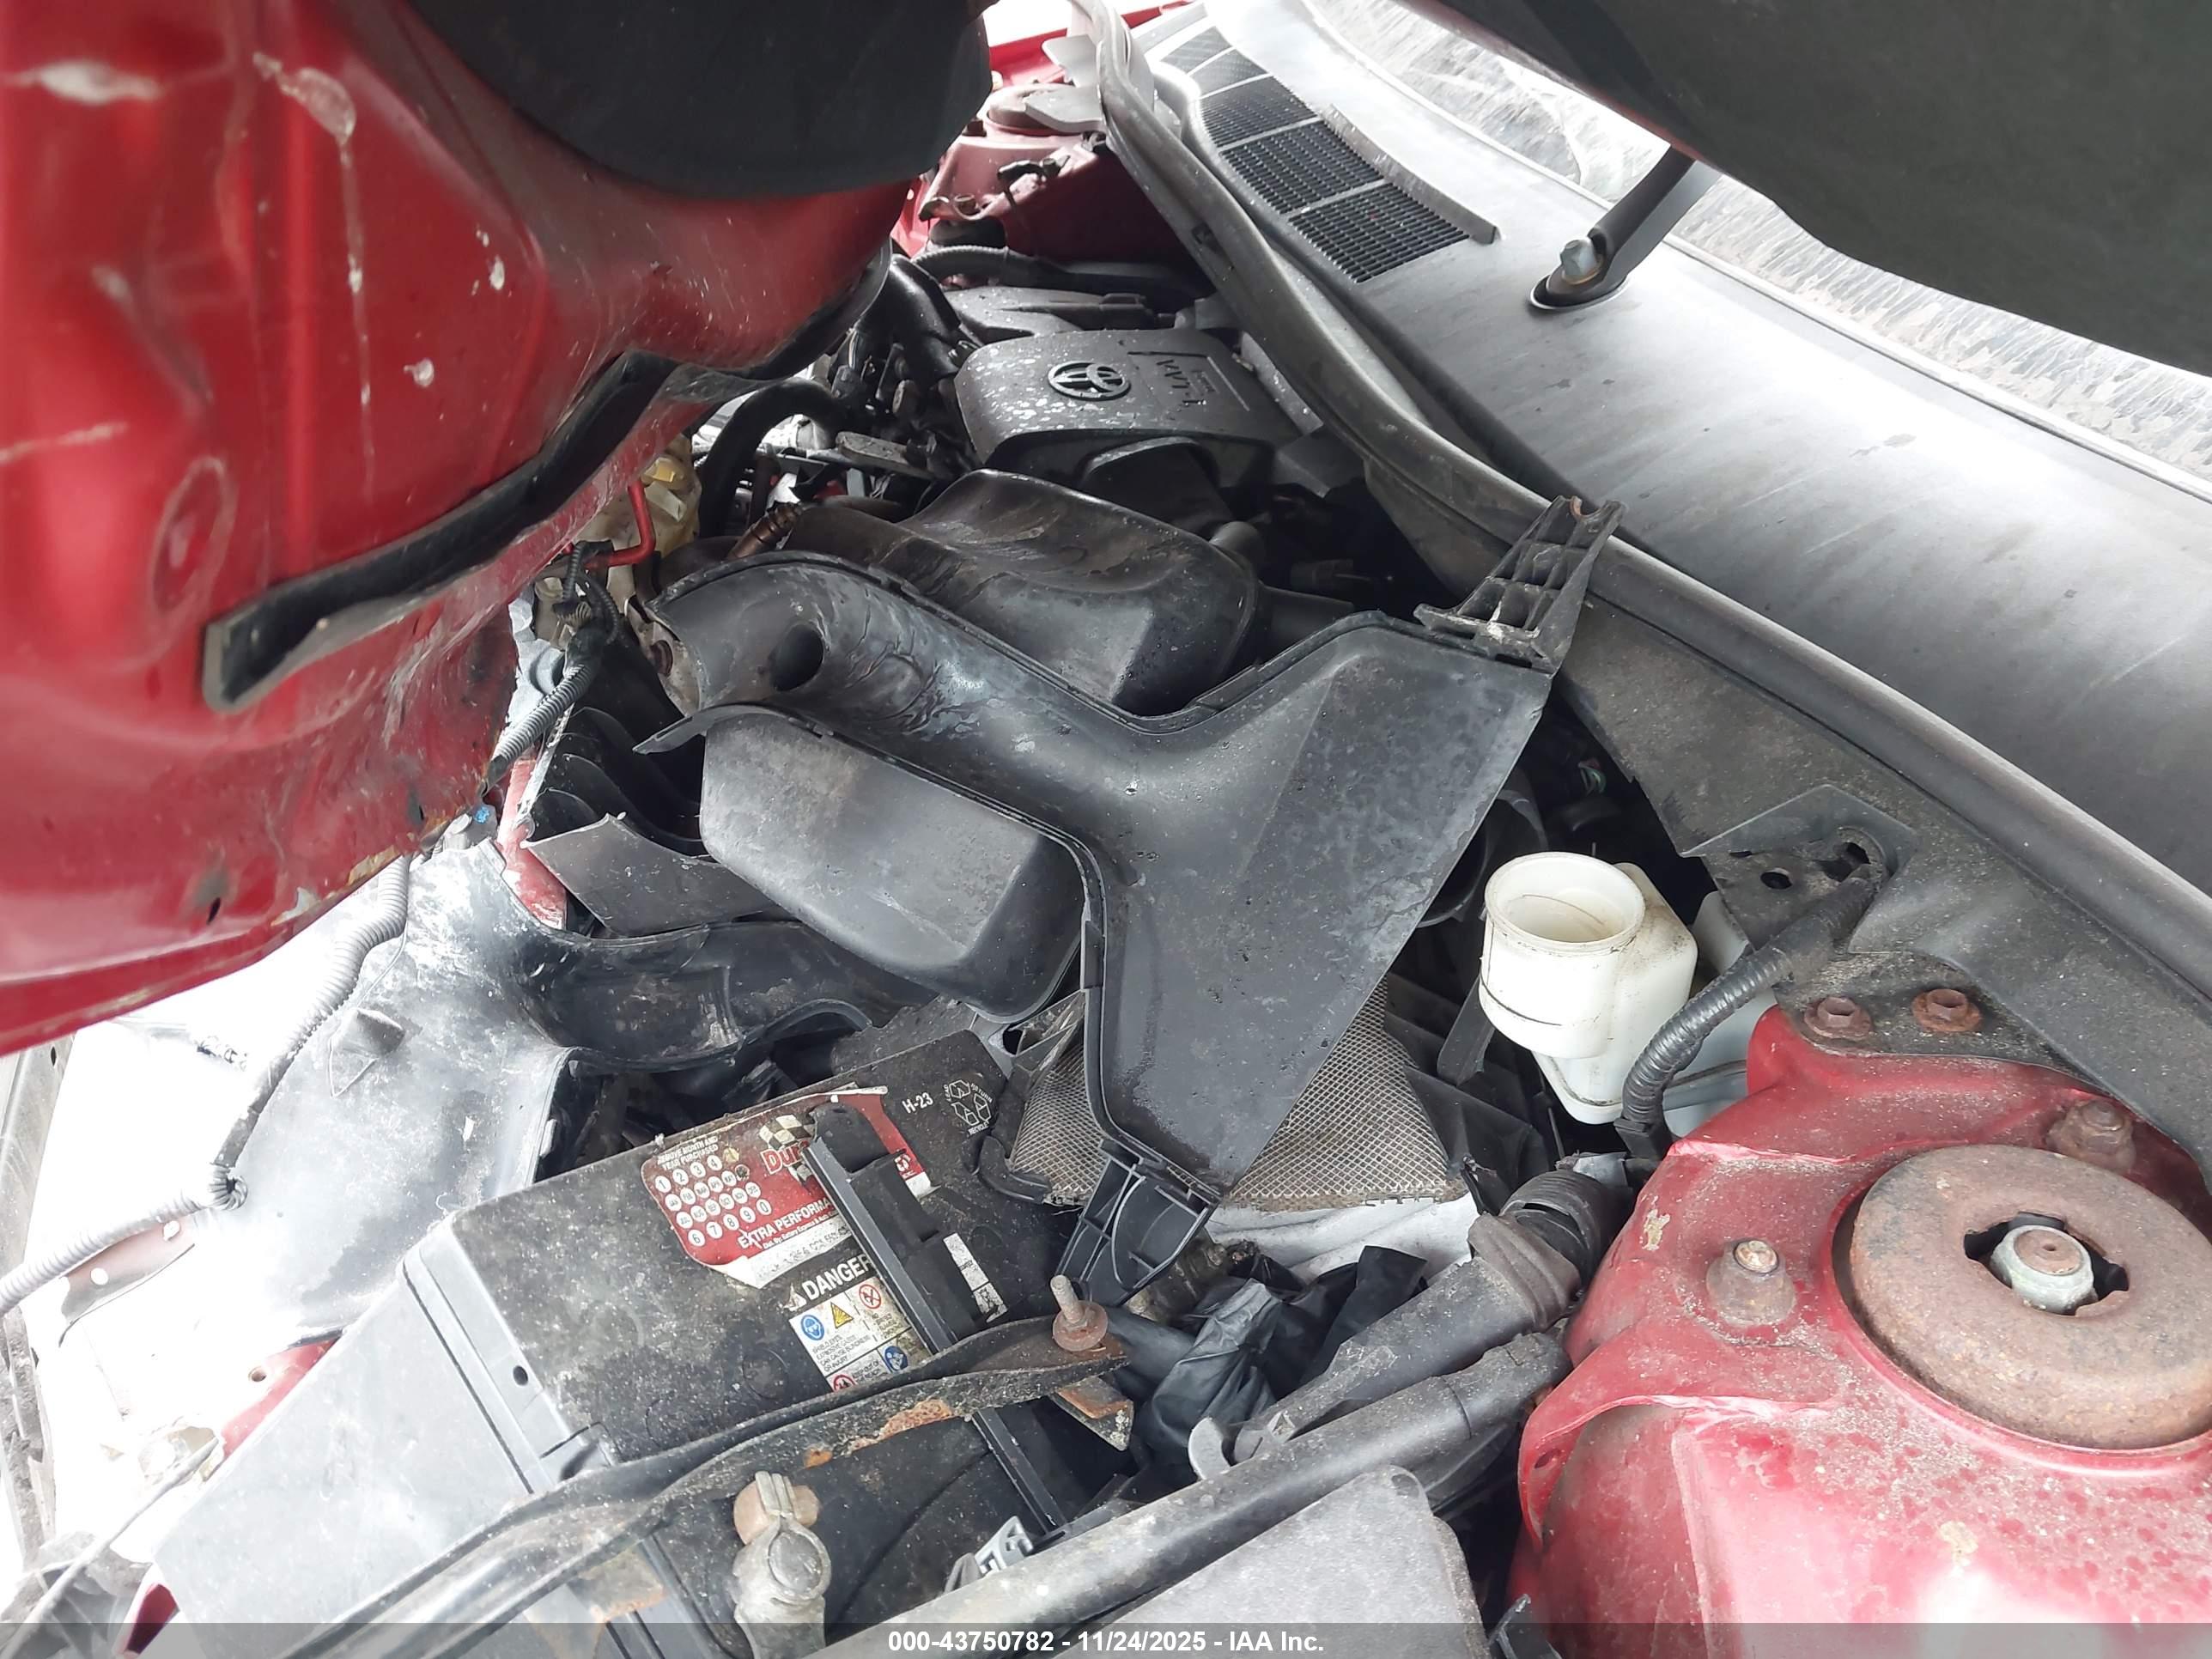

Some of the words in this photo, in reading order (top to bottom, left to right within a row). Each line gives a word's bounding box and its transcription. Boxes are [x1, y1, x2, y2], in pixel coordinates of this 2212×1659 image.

[902, 1092, 933, 1114] H-23
[968, 1122, 989, 1135] RECYCLE
[738, 1223, 777, 1249] EXTRA
[775, 1197, 831, 1231] PERFORMA
